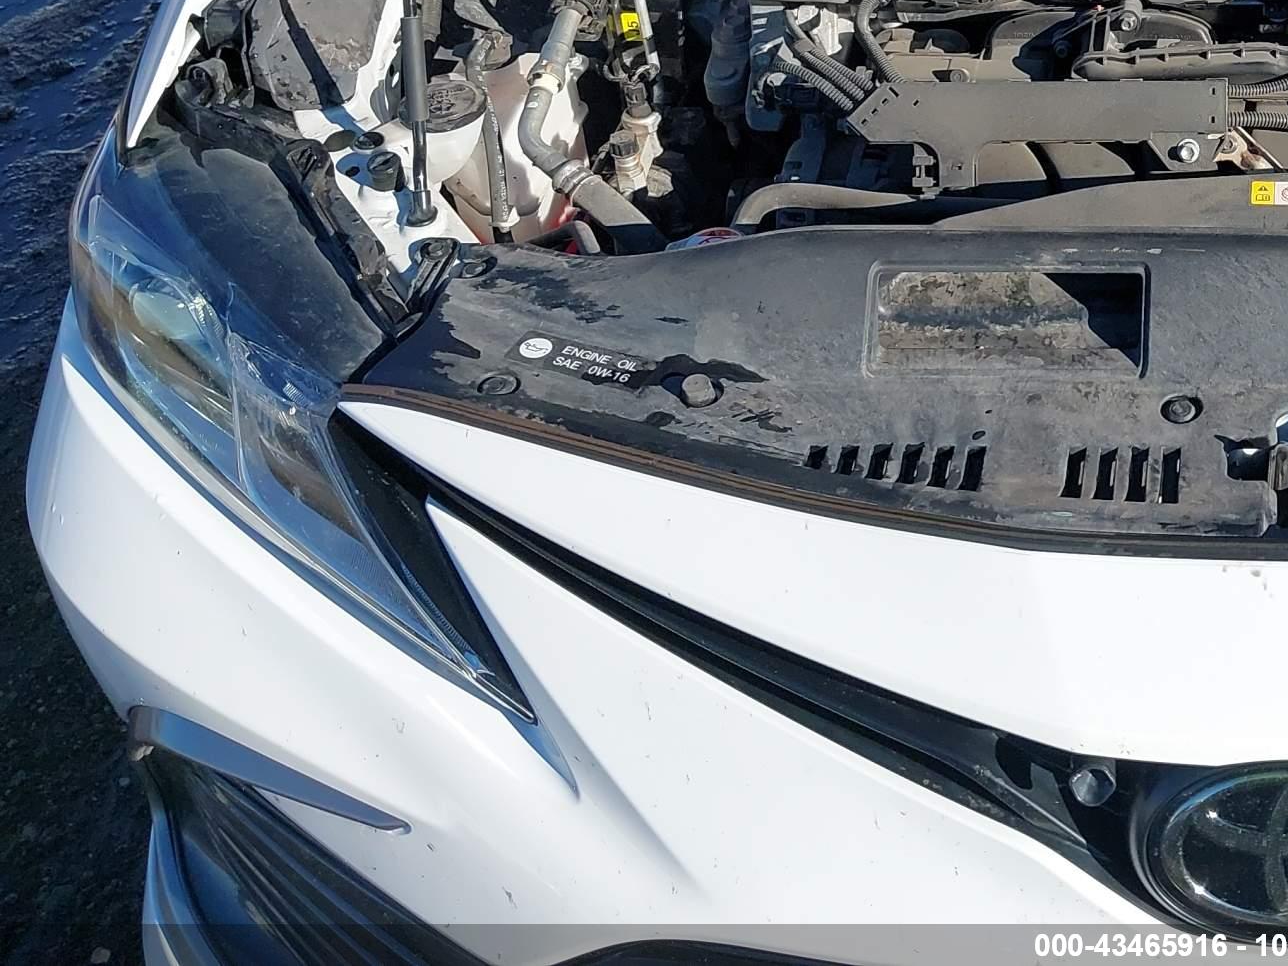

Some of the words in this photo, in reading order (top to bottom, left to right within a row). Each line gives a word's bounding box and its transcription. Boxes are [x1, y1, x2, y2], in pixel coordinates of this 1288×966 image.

[552, 356, 583, 370] SAE
[588, 365, 631, 383] 0W-16
[561, 345, 613, 365] ENGINE
[617, 359, 637, 372] OIL
